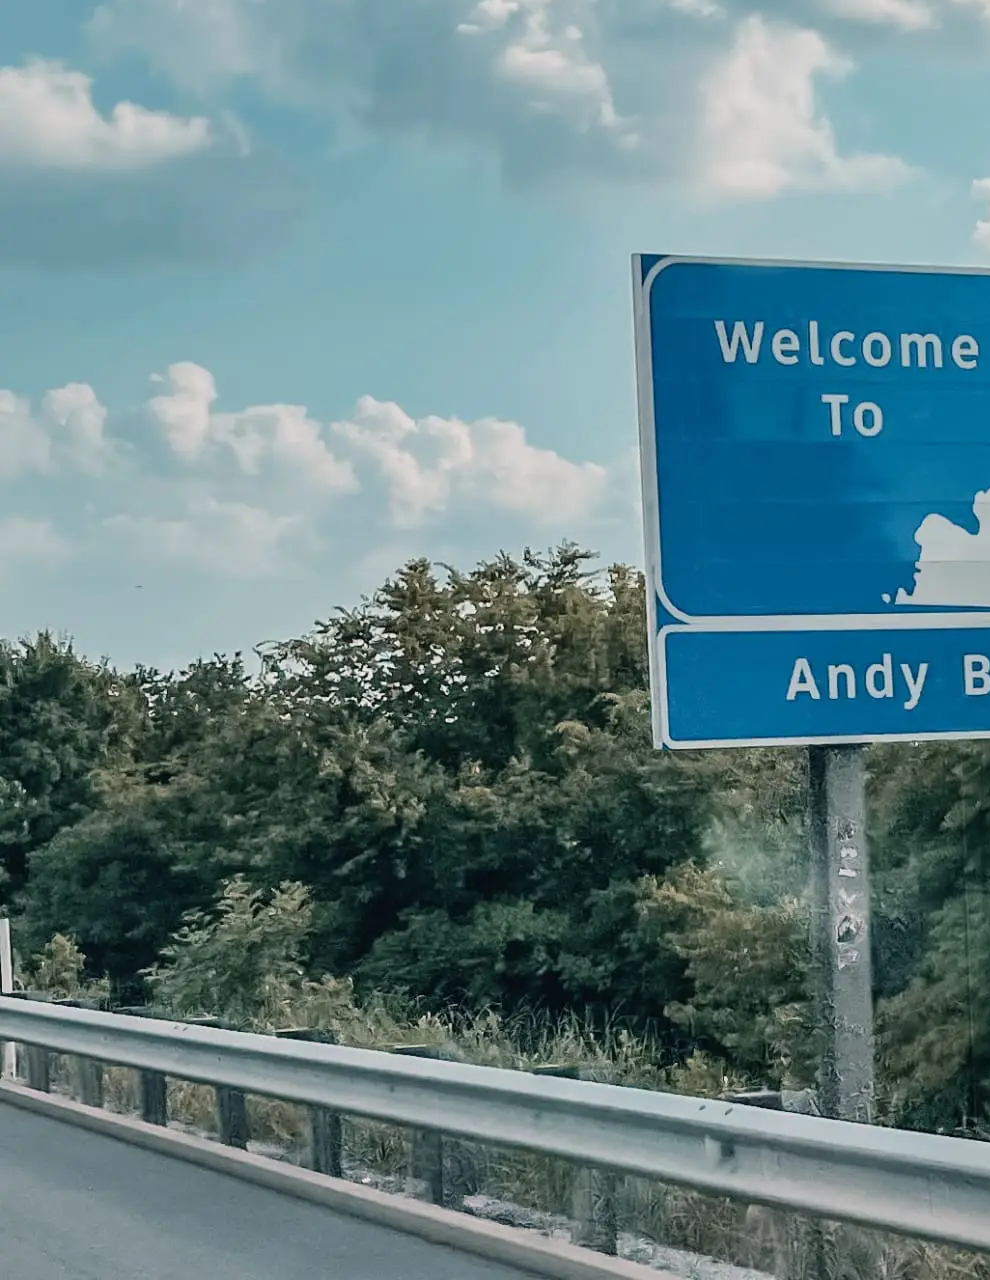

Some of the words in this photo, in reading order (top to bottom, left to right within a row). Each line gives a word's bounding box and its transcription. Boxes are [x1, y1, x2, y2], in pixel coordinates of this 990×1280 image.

[713, 320, 979, 370] Welcome
[821, 393, 884, 437] To
[785, 652, 929, 711] Andy
